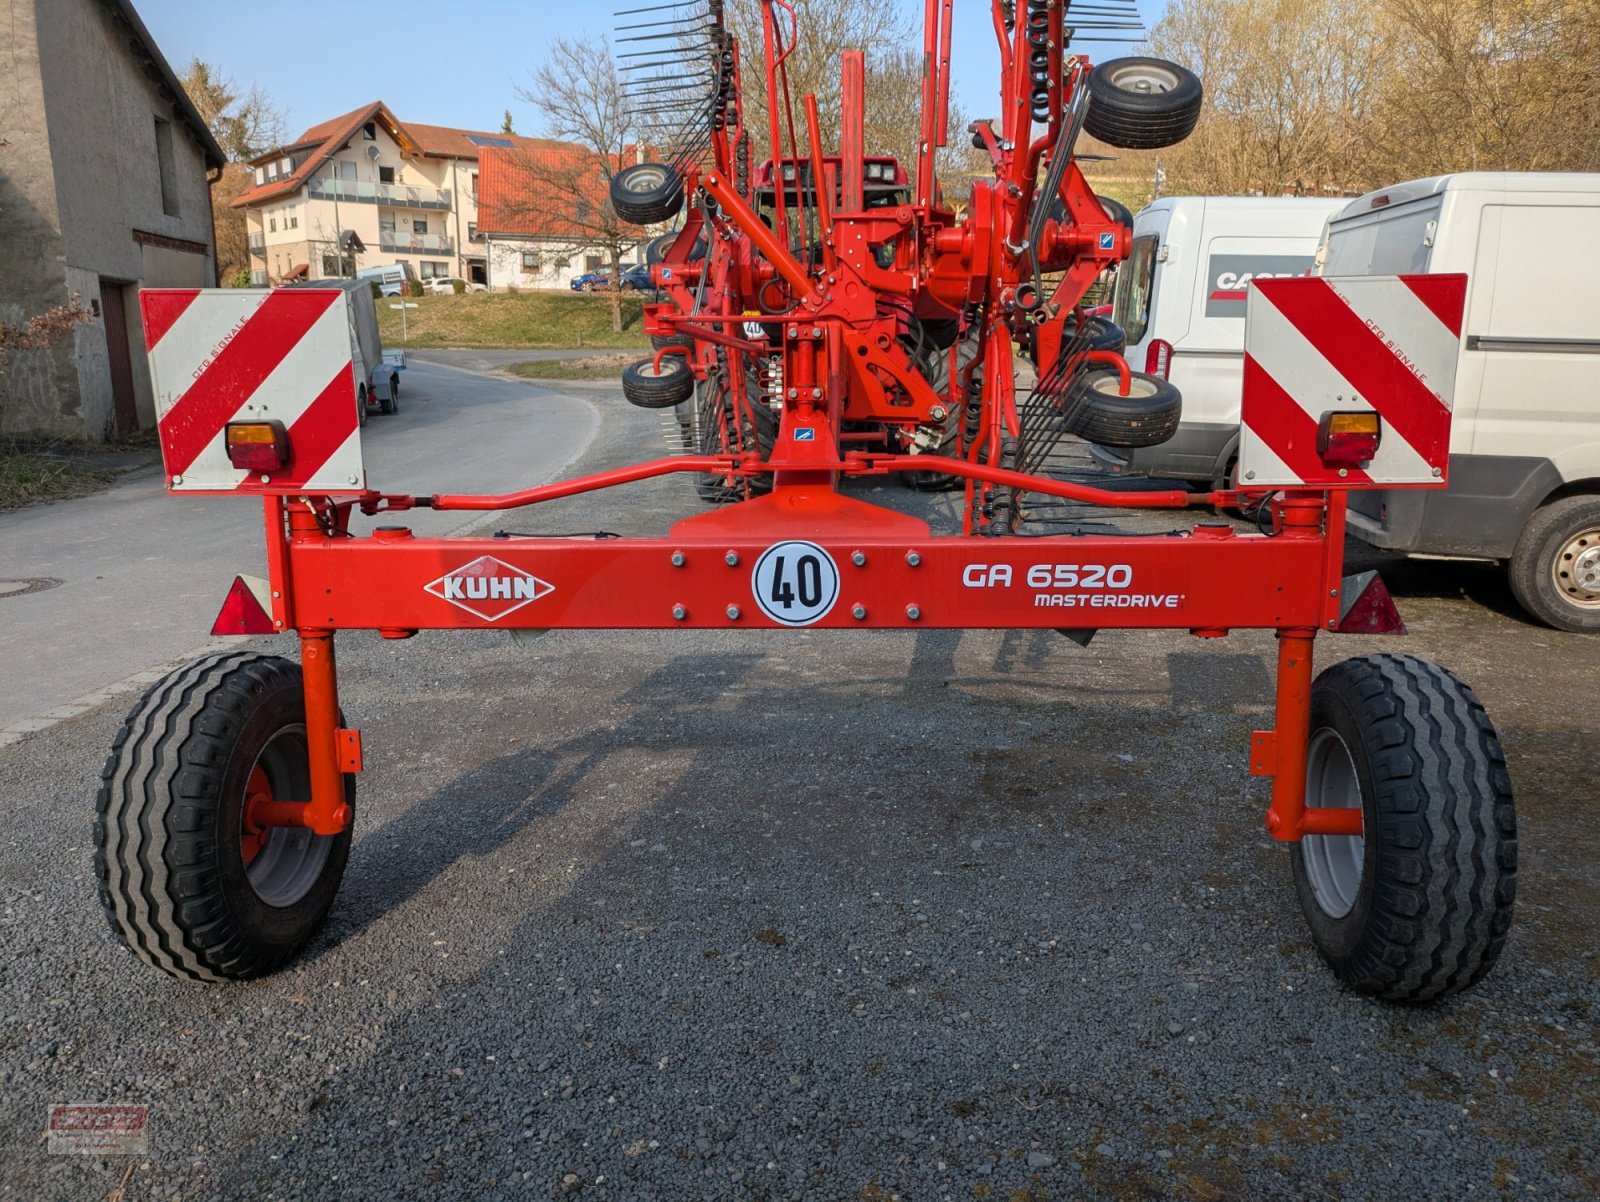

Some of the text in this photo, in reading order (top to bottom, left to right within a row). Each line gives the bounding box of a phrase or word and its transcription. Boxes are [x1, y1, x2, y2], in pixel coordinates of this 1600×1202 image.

[1365, 318, 1385, 339] CFG
[192, 359, 211, 379] CFG
[443, 576, 536, 600] KUHN
[772, 554, 822, 609] 40
[962, 564, 1133, 588] GA 6520
